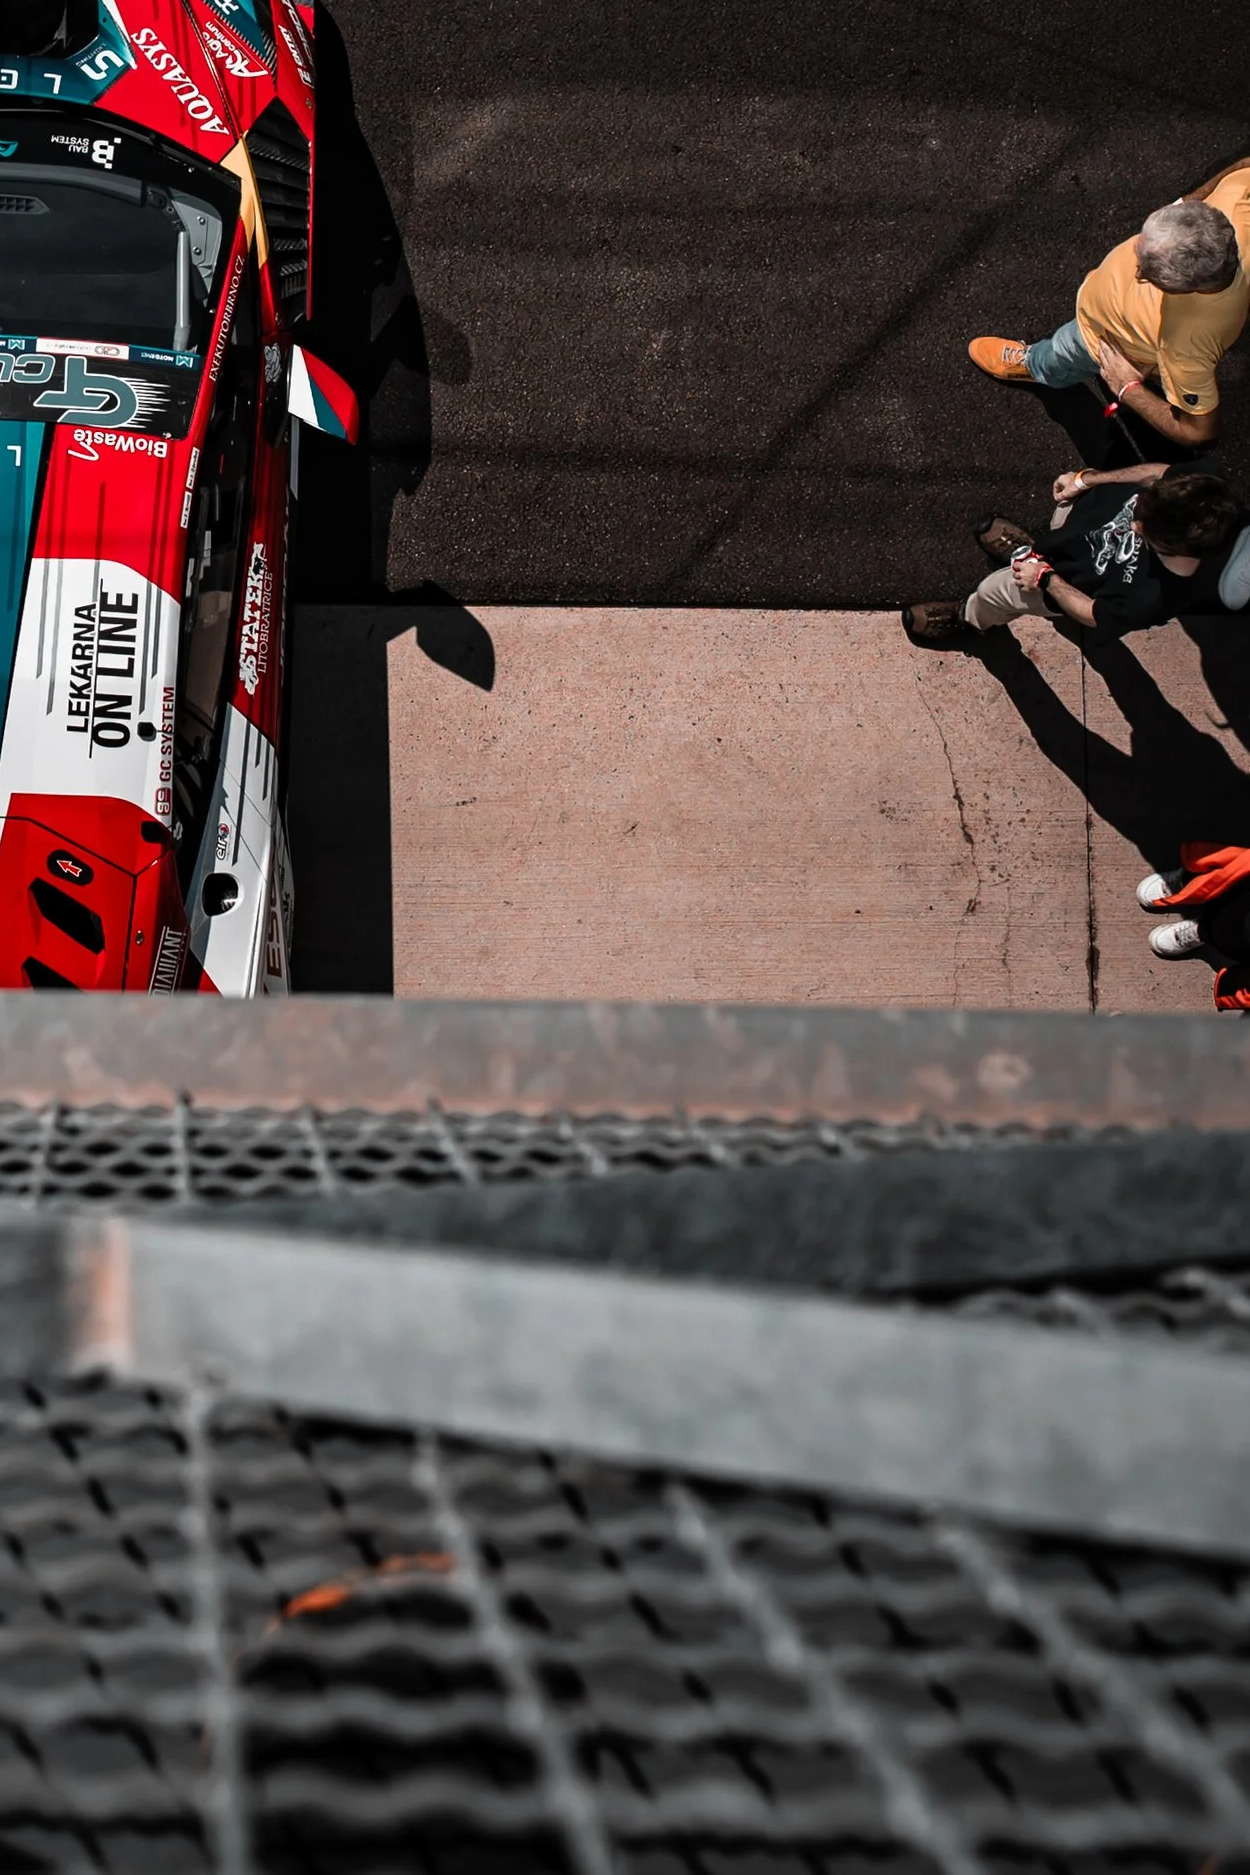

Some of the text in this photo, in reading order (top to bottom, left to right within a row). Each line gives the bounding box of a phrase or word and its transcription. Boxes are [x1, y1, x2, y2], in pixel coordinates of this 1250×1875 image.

[206, 21, 234, 52] centrum
[130, 27, 230, 135] AQUASYS
[51, 135, 90, 146] SYSTEM
[68, 144, 89, 153] BAU
[207, 254, 245, 382] EXEKUTORBRNO.CZ
[73, 428, 168, 458] BioWaste
[240, 568, 264, 670] STATEK
[257, 571, 273, 673] LITOBRATRICE
[92, 591, 139, 748] ON LINE
[160, 686, 174, 755] SYSTEM
[159, 760, 172, 782] GC
[216, 833, 228, 860] elf
